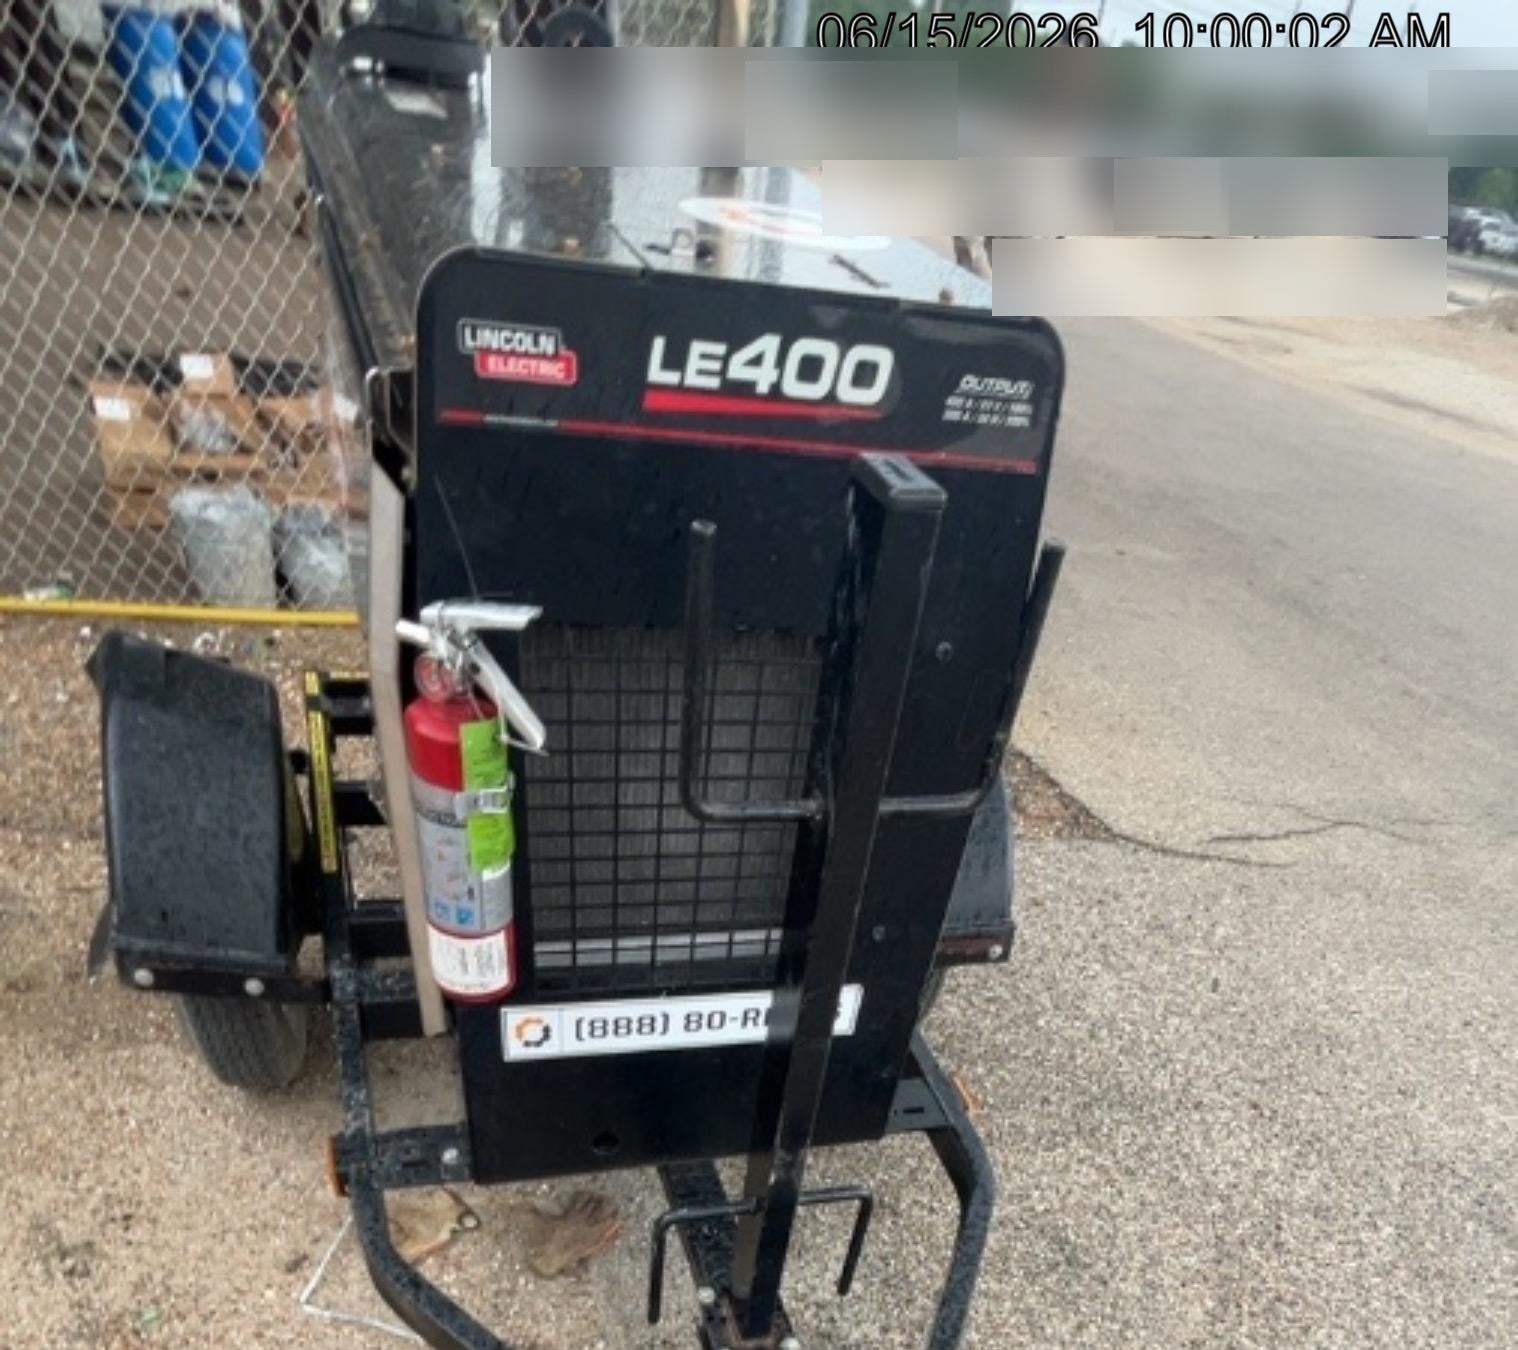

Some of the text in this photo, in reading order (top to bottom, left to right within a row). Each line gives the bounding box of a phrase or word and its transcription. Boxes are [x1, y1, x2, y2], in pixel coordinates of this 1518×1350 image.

[463, 326, 557, 357] LINCOLN
[486, 354, 567, 380] ELECTRIC
[647, 332, 895, 406] LE400
[575, 1013, 671, 1042] (888)
